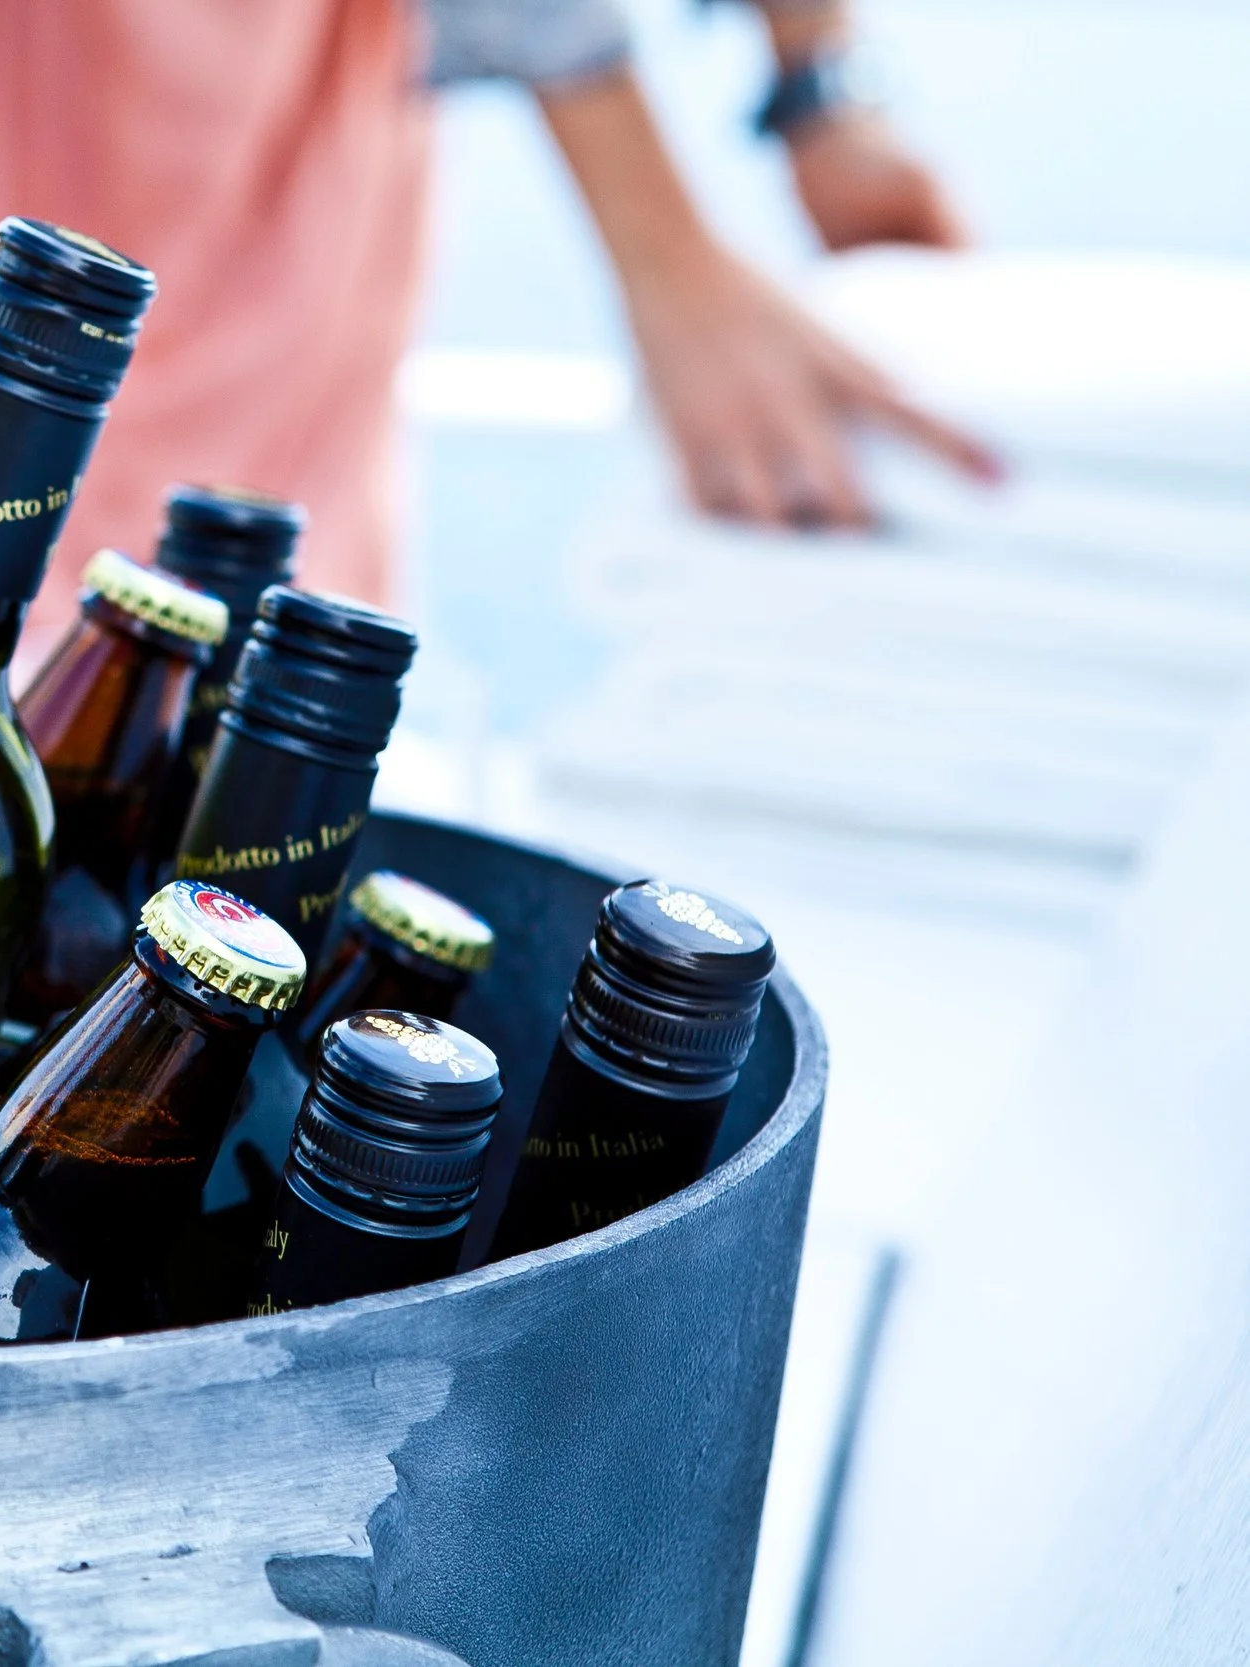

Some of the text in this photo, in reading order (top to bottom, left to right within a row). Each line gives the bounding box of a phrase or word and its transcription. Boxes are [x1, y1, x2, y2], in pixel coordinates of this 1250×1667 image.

[47, 486, 69, 511] in
[285, 835, 314, 863] in
[556, 1131, 581, 1159] in
[588, 1129, 666, 1159] Italia
